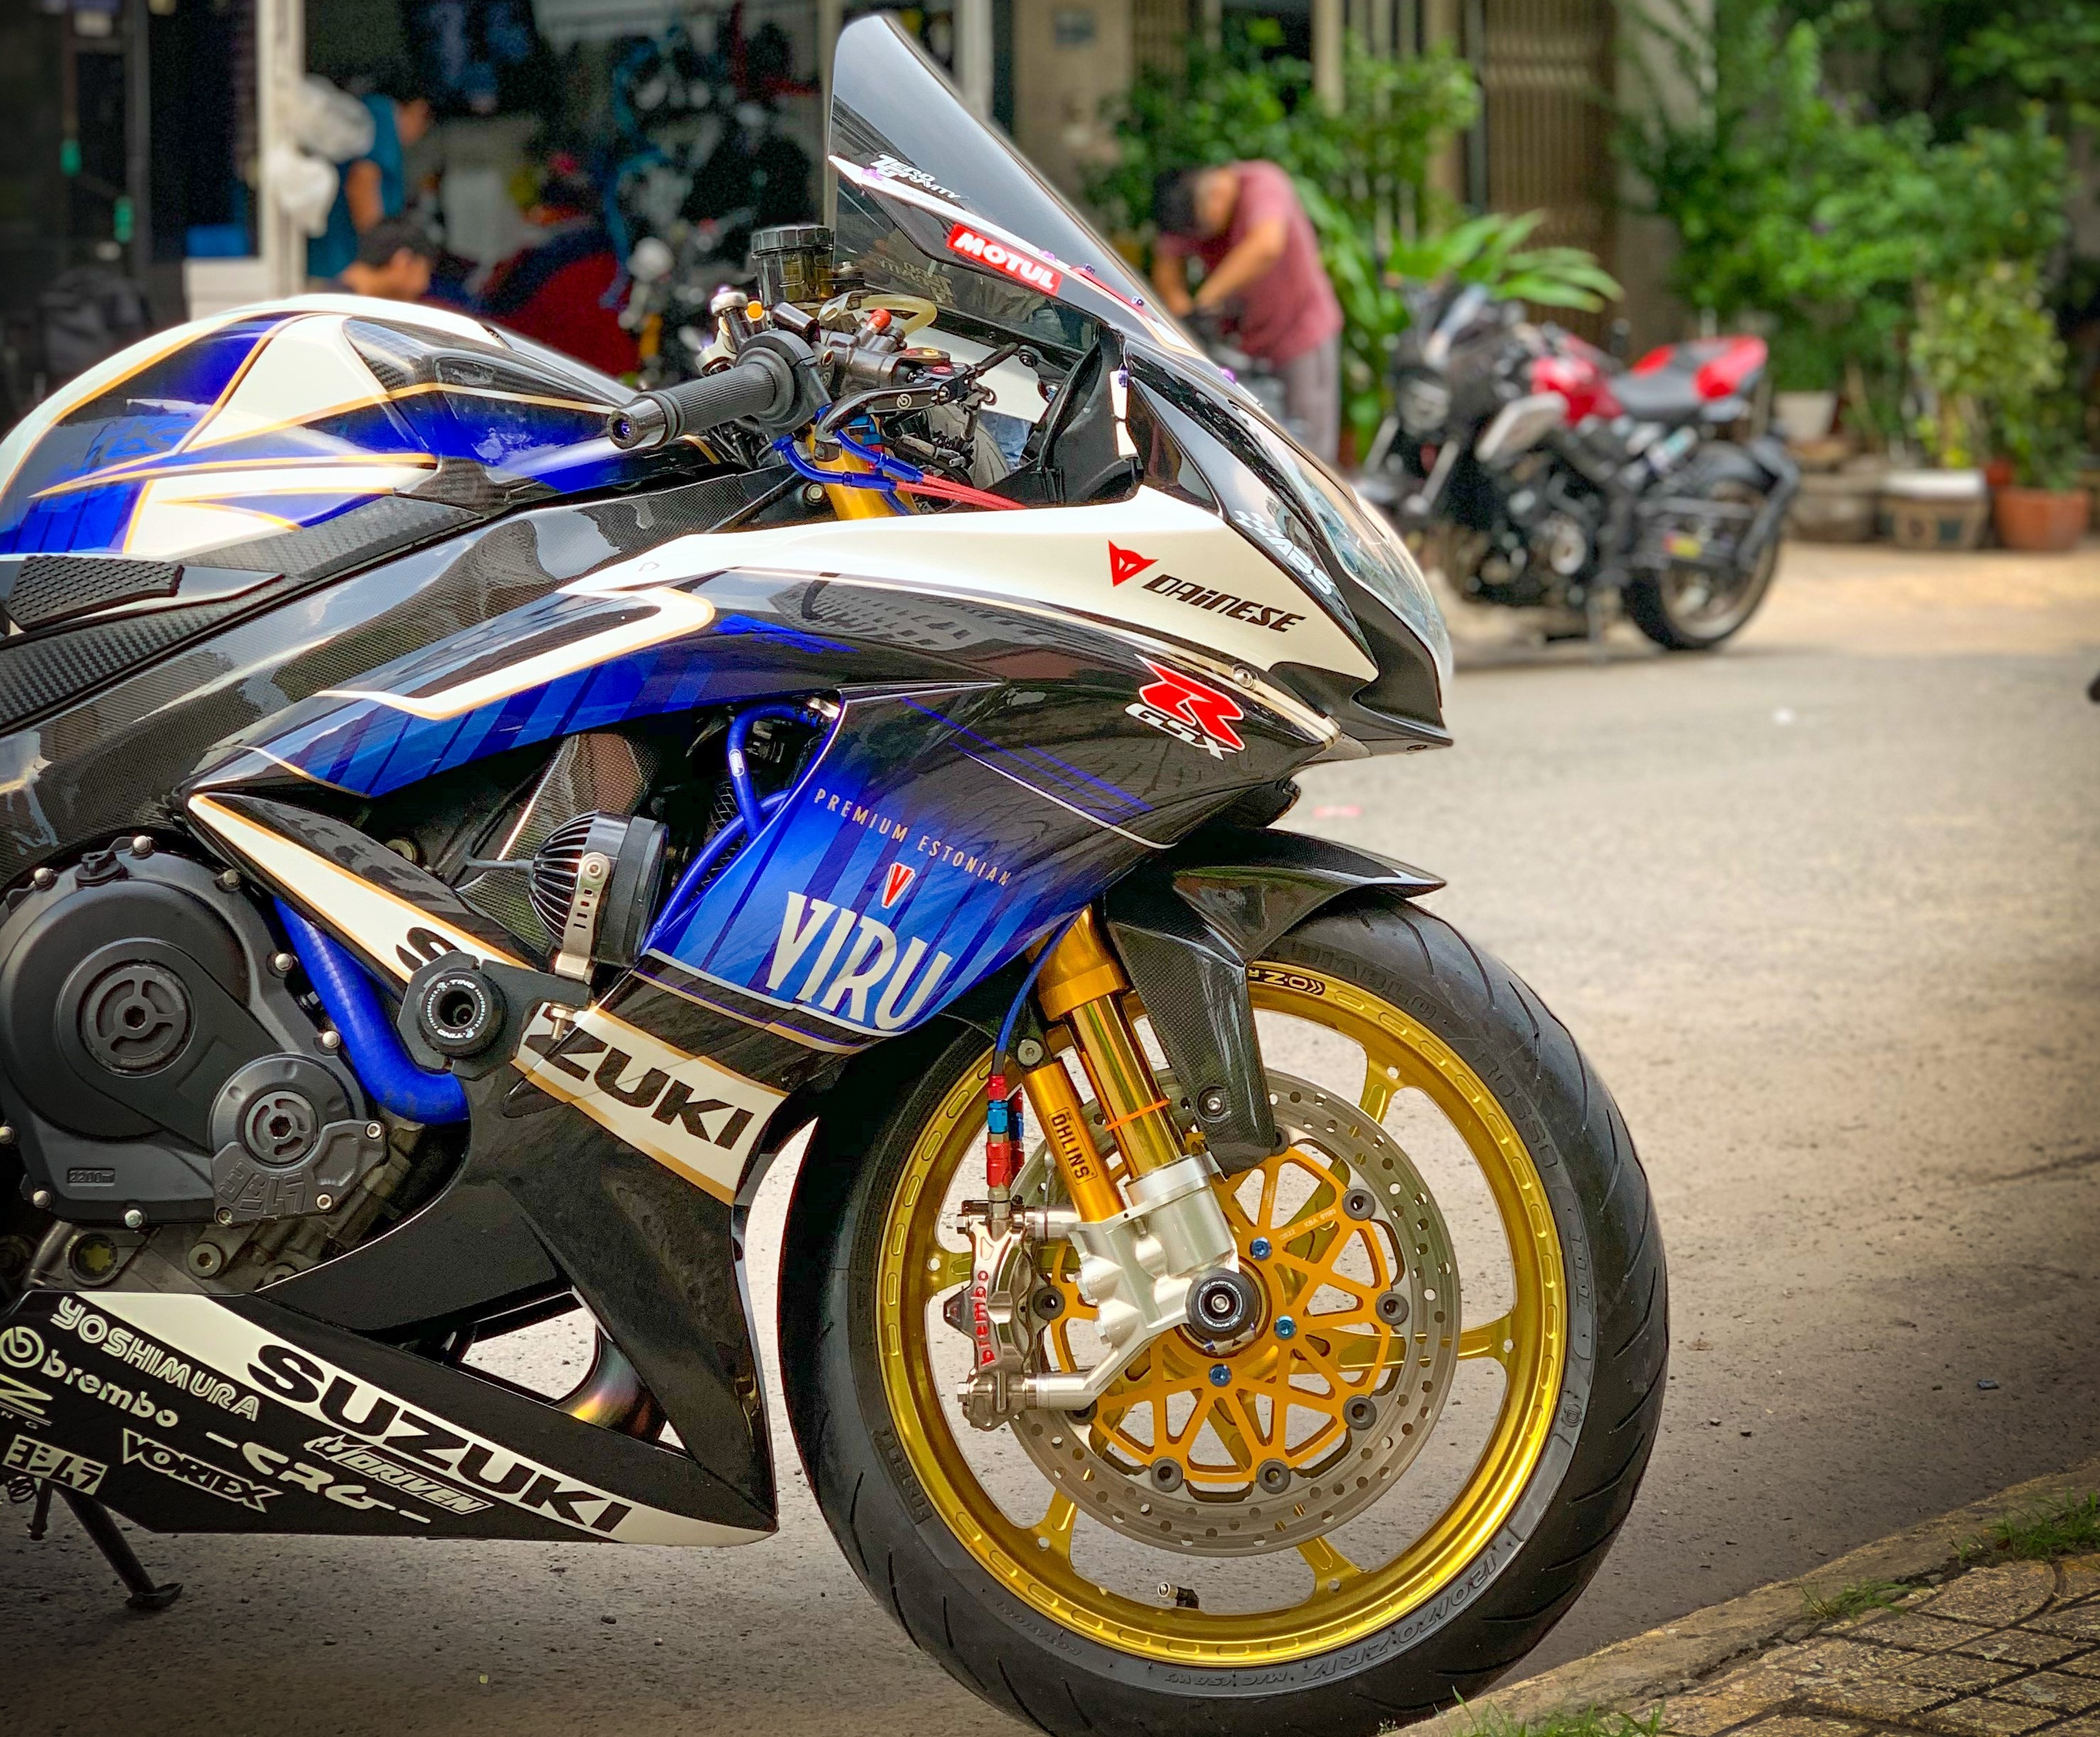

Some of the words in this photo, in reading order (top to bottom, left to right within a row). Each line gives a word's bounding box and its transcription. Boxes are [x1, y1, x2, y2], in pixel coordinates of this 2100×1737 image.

[954, 232, 1054, 289] MOTUL
[1266, 537, 1337, 595] ABS
[1125, 702, 1238, 761] GSX
[814, 787, 908, 843] PREMIUM
[917, 834, 1012, 886] ESTONIAN
[765, 891, 953, 1031] VIRU
[1052, 1111, 1090, 1179] ÖHLINS
[1473, 1052, 1558, 1168] ROSSO
[50, 1296, 260, 1422] YOSHIMURA
[974, 1270, 996, 1367] brembo
[41, 1348, 179, 1428] brembo
[6, 1437, 106, 1493] ヨシムラ
[123, 1428, 284, 1514] VORTEX
[242, 1441, 387, 1510] CRG
[247, 1344, 632, 1533] SUZUKI
[341, 1453, 485, 1511] DRIVEN
[1397, 1552, 1497, 1645] 120/70
